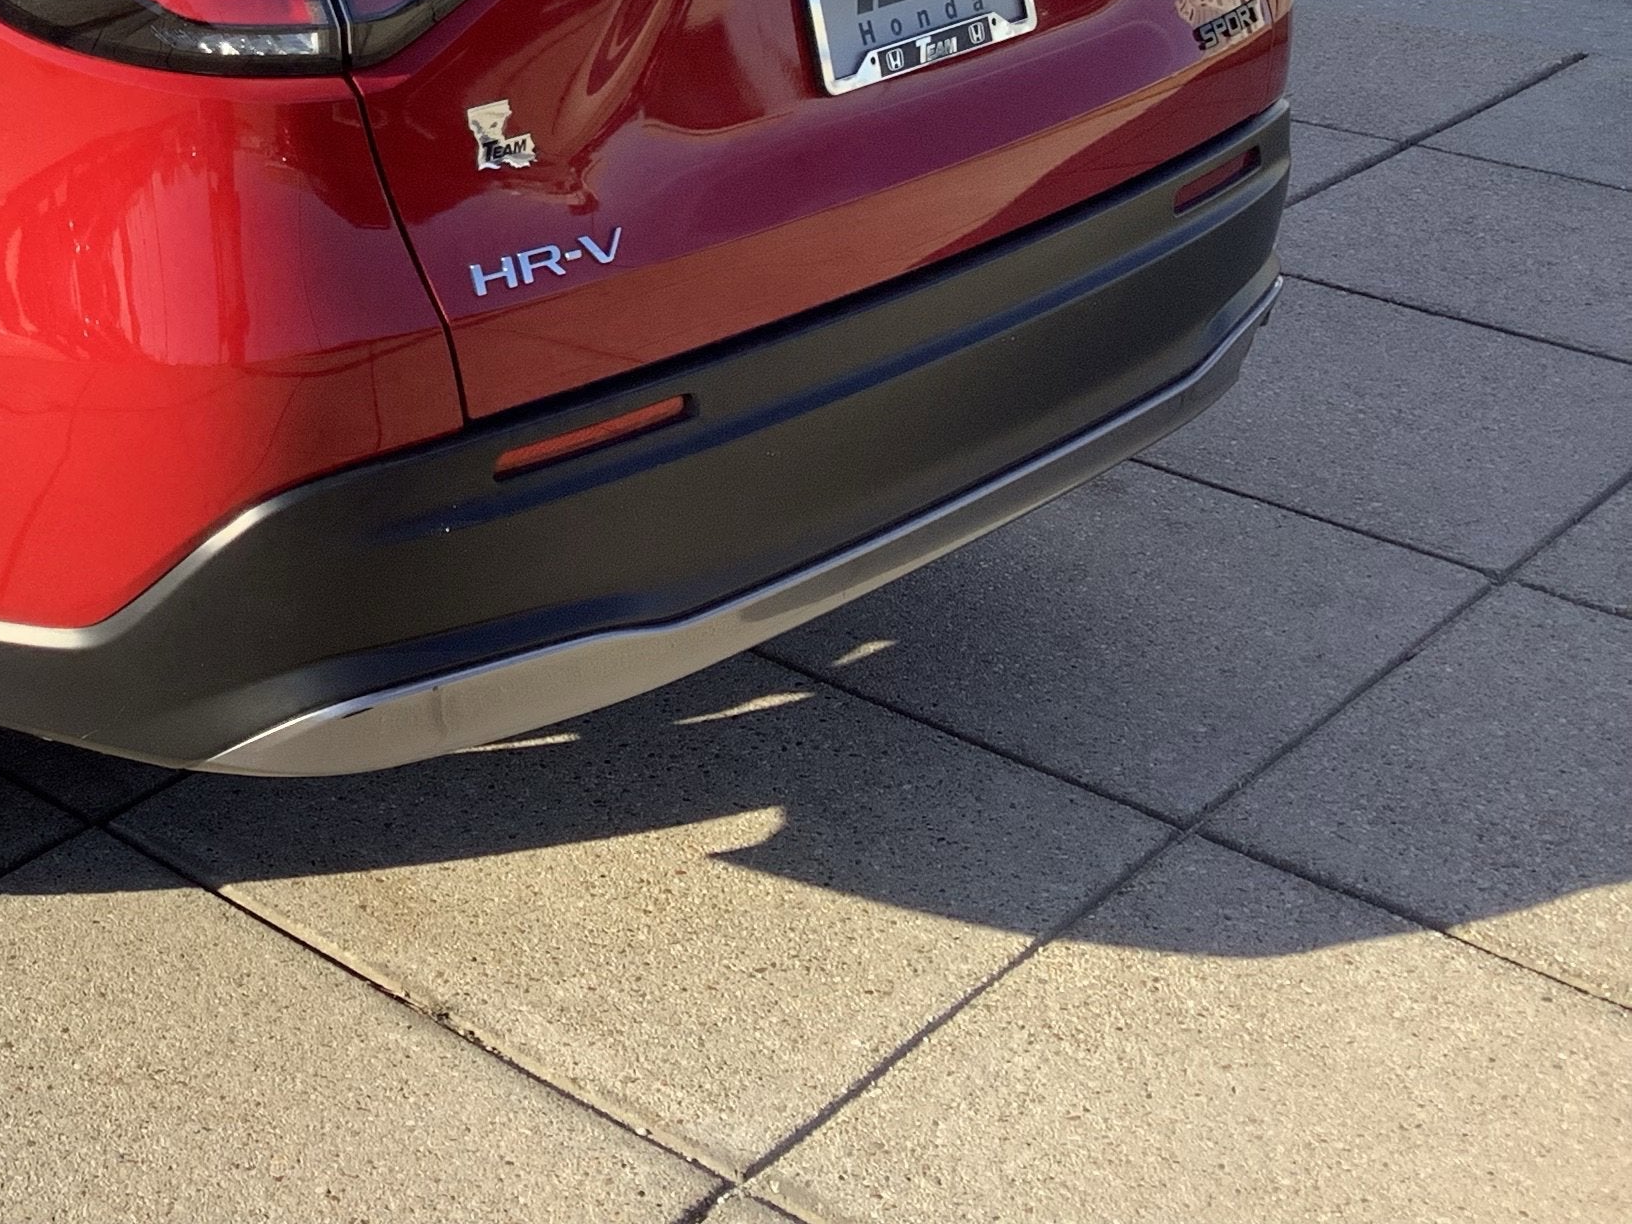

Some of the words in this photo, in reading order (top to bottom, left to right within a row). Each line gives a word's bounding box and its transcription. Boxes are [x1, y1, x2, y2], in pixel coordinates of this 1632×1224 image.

[916, 34, 957, 64] TEAM
[483, 139, 527, 162] TEAM
[469, 226, 622, 297] HR-V
